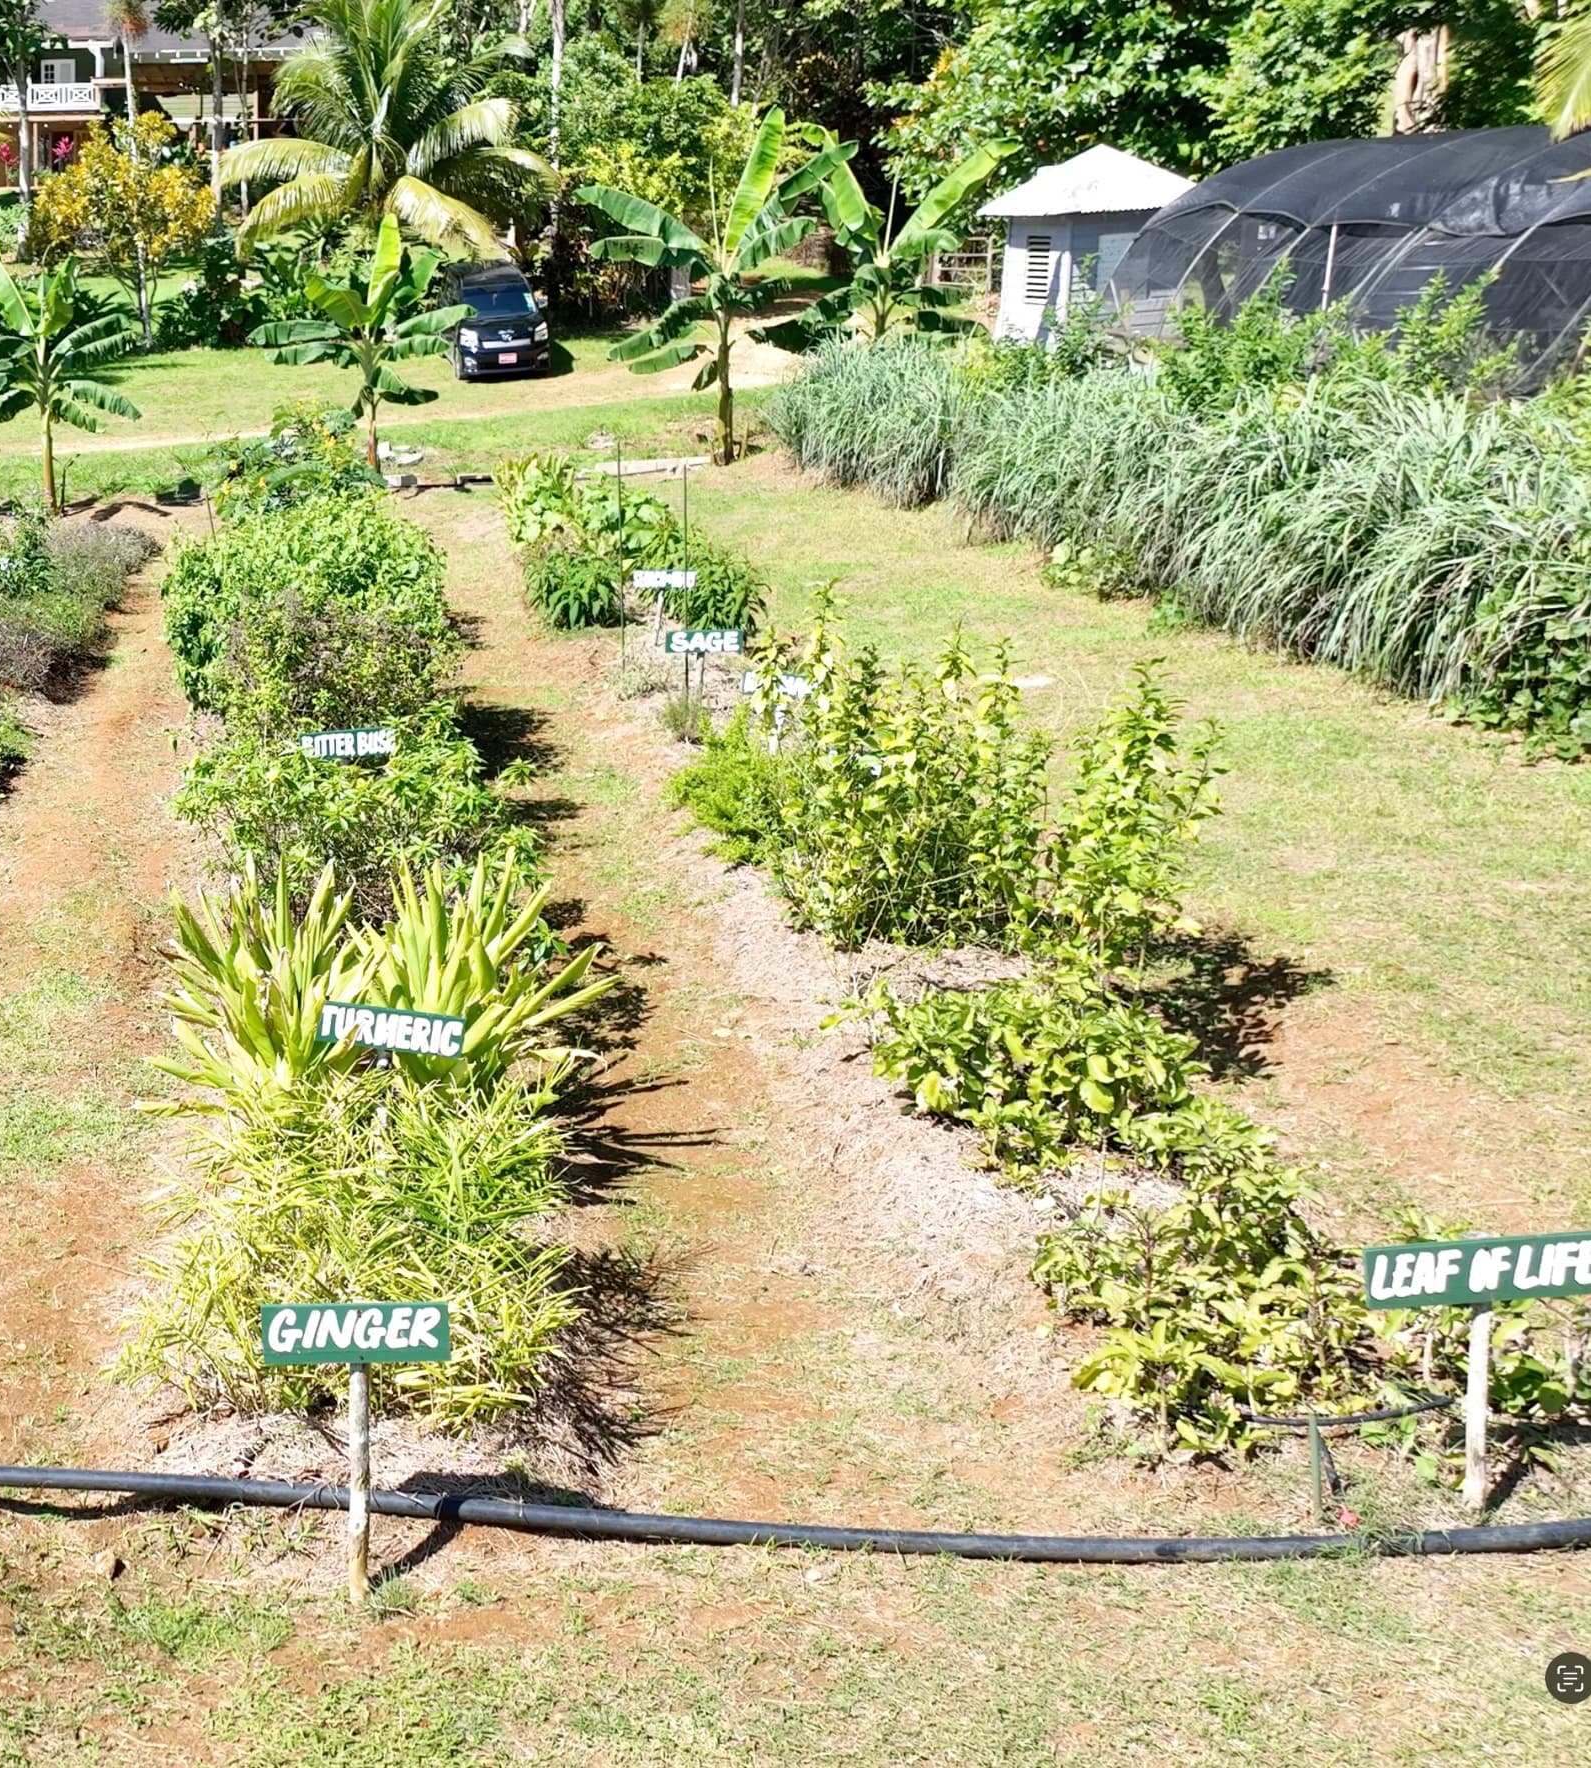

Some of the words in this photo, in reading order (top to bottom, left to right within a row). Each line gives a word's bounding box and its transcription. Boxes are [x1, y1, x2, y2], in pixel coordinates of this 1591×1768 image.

[670, 631, 740, 651] SAGE
[301, 733, 356, 757] BITTER
[321, 1004, 464, 1056] TURMERIC
[1370, 1249, 1463, 1301] LEAF
[1468, 1246, 1512, 1293] OF
[268, 1307, 442, 1353] GINGER
